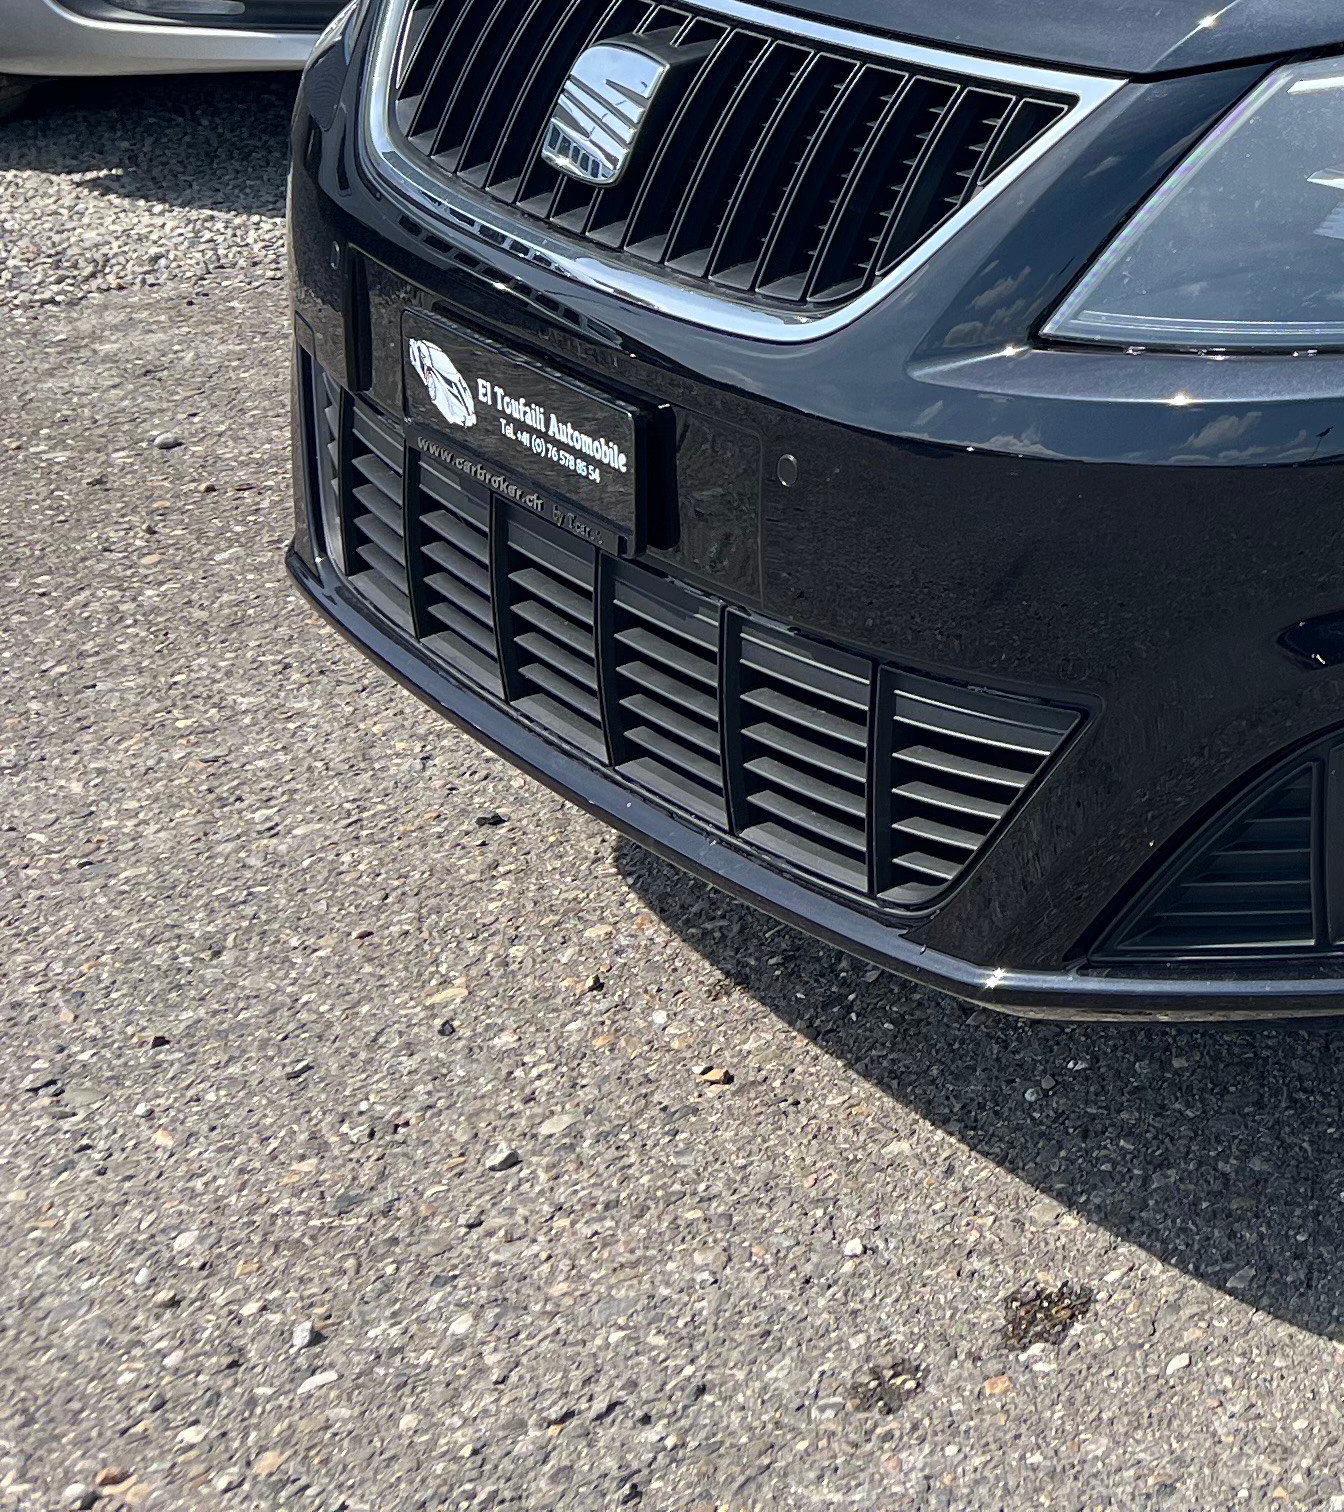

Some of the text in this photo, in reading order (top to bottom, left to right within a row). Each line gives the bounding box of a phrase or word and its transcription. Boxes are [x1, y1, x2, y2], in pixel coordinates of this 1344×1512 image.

[476, 378, 627, 473] El Toufaili Automobile
[517, 431, 530, 447] +41
[532, 434, 546, 457] (0)
[547, 444, 558, 462] 76
[559, 450, 576, 470] 578
[576, 459, 588, 476] 85
[588, 465, 600, 484] 54
[417, 436, 544, 512] www.carbroker.ch
